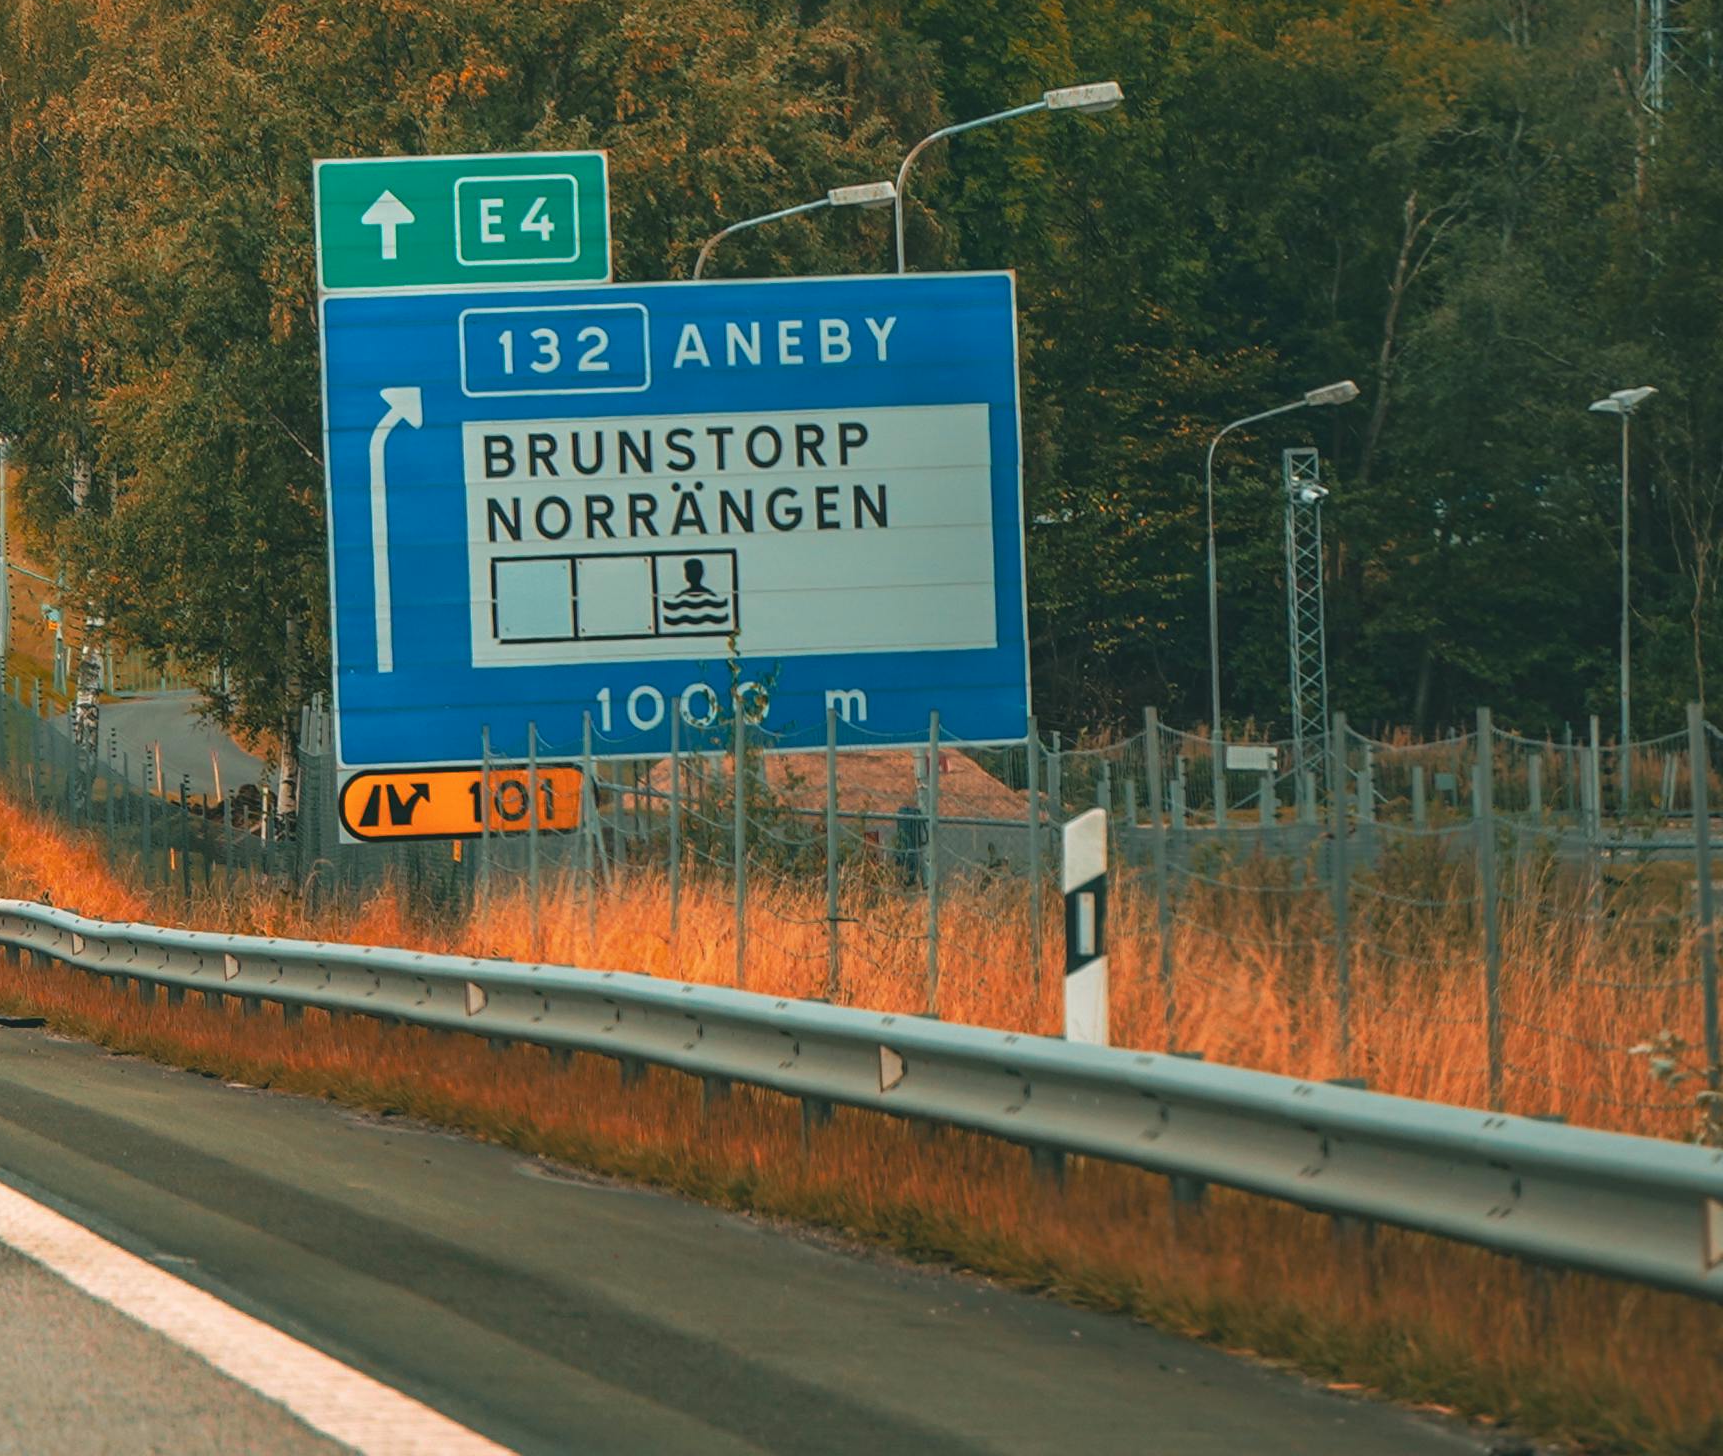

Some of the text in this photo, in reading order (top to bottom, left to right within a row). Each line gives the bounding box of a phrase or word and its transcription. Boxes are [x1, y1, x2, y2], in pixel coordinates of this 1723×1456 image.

[481, 196, 555, 242] E4
[499, 316, 897, 374] 132 ANEBY
[484, 421, 869, 479] BRUNSTORP
[487, 481, 888, 543] NORRÄNGEN
[597, 681, 868, 732] 1000 m
[469, 777, 555, 824] 101
